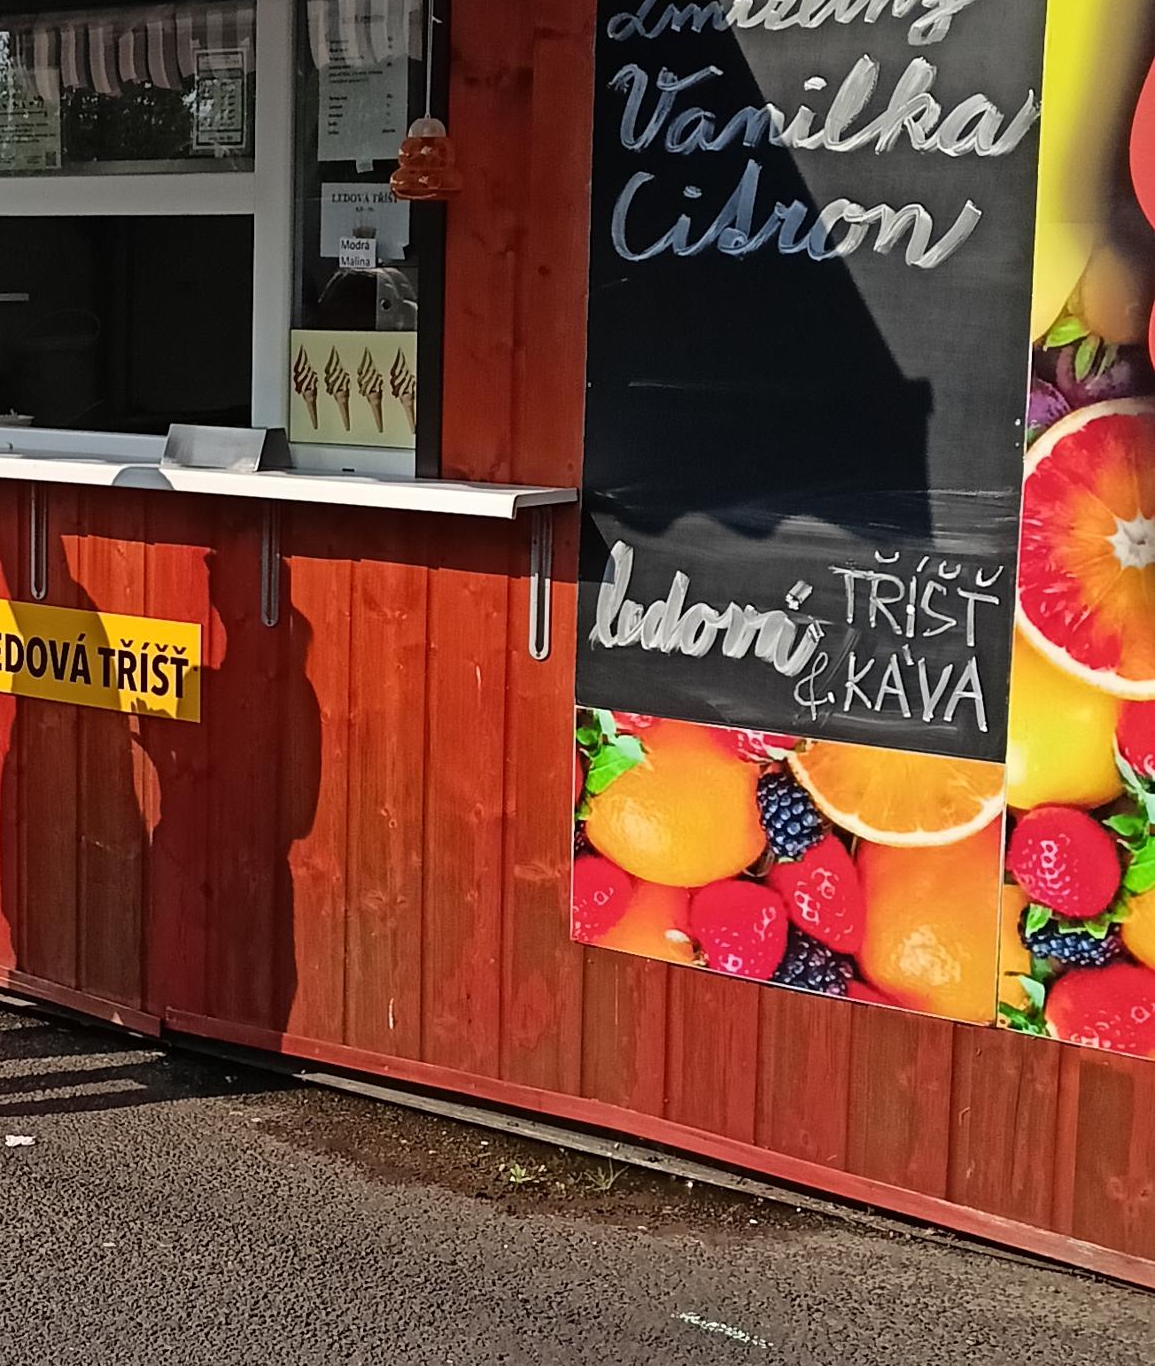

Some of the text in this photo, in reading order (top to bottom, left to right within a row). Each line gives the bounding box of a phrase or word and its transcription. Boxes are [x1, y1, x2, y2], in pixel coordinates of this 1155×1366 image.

[606, 54, 1042, 157] Vanilka
[341, 239, 371, 251] Modrá
[341, 256, 371, 267] Malina
[98, 638, 190, 698] TŘÍŠŤ
[844, 644, 988, 733] KÁVA
